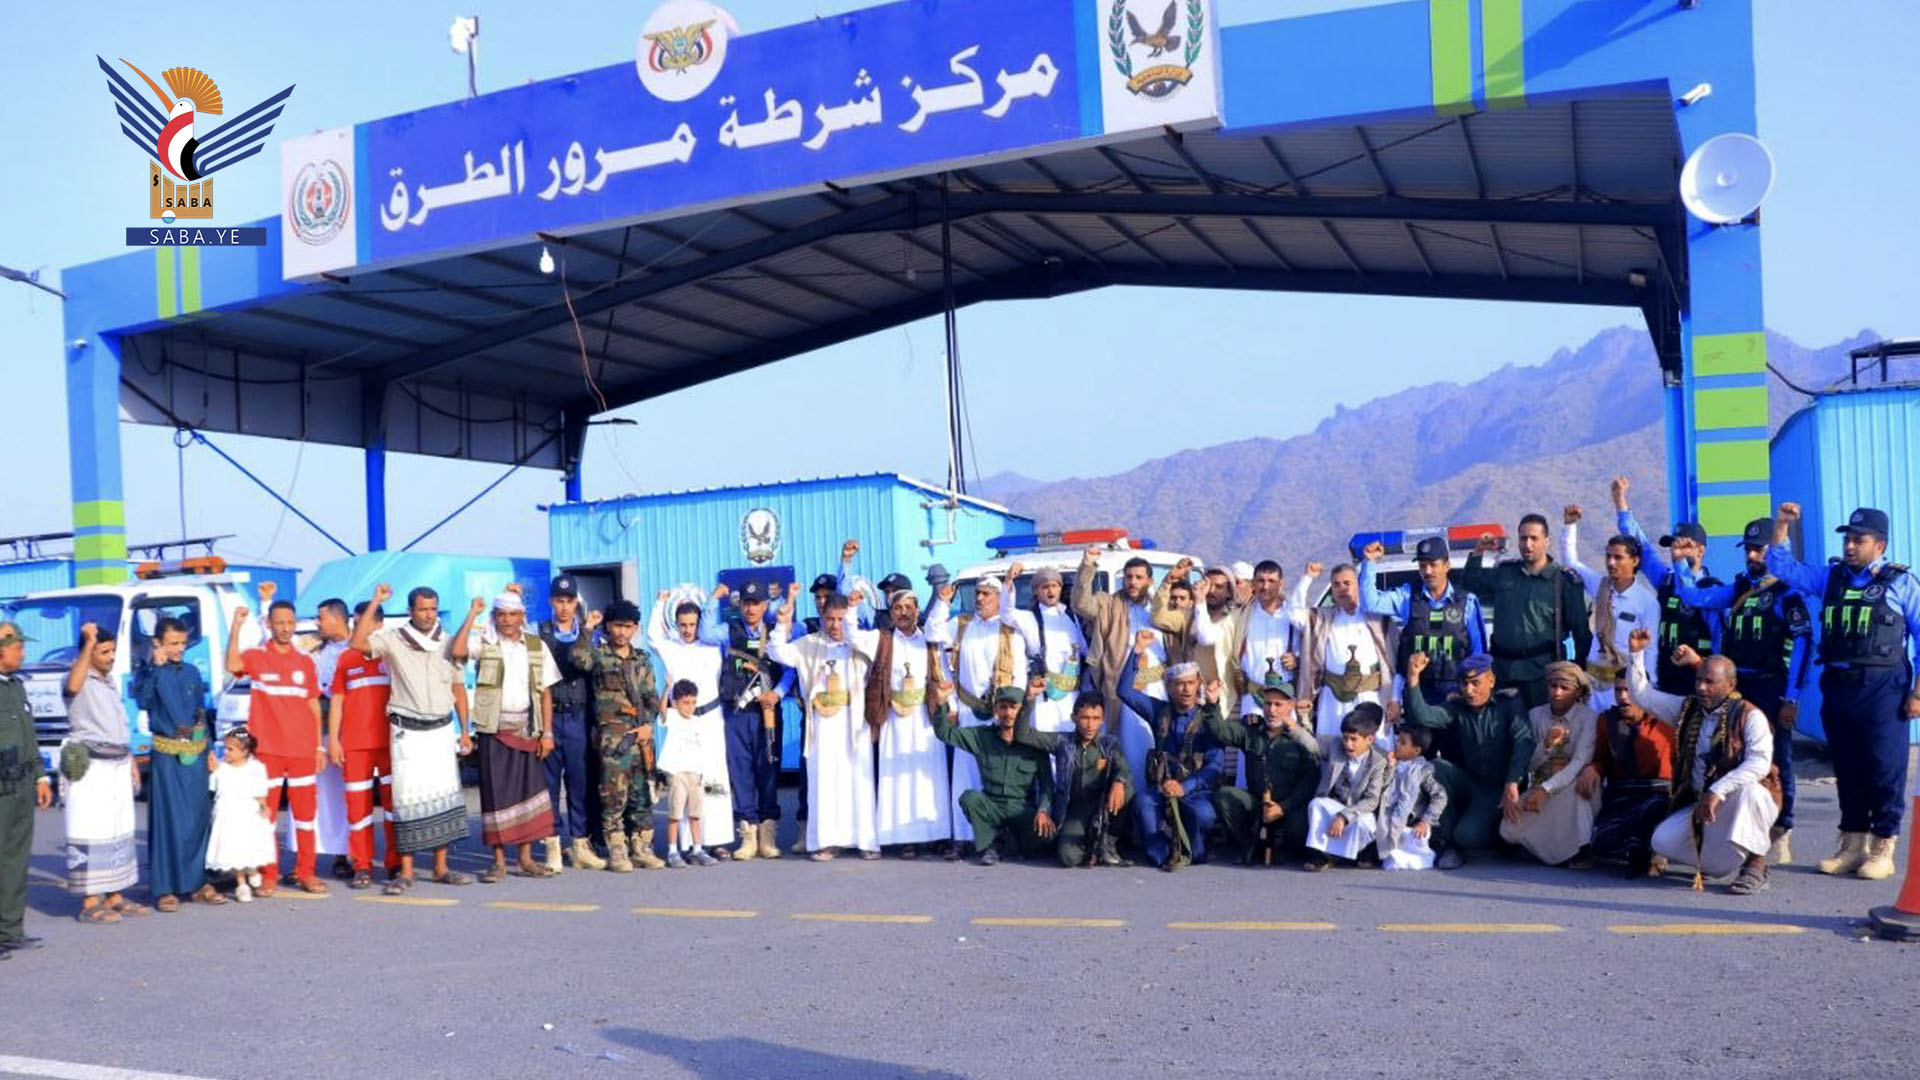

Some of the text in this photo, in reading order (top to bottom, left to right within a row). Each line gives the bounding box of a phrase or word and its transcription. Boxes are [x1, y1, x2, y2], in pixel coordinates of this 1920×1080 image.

[380, 44, 1060, 232] مركز شرطة مرور الطرق
